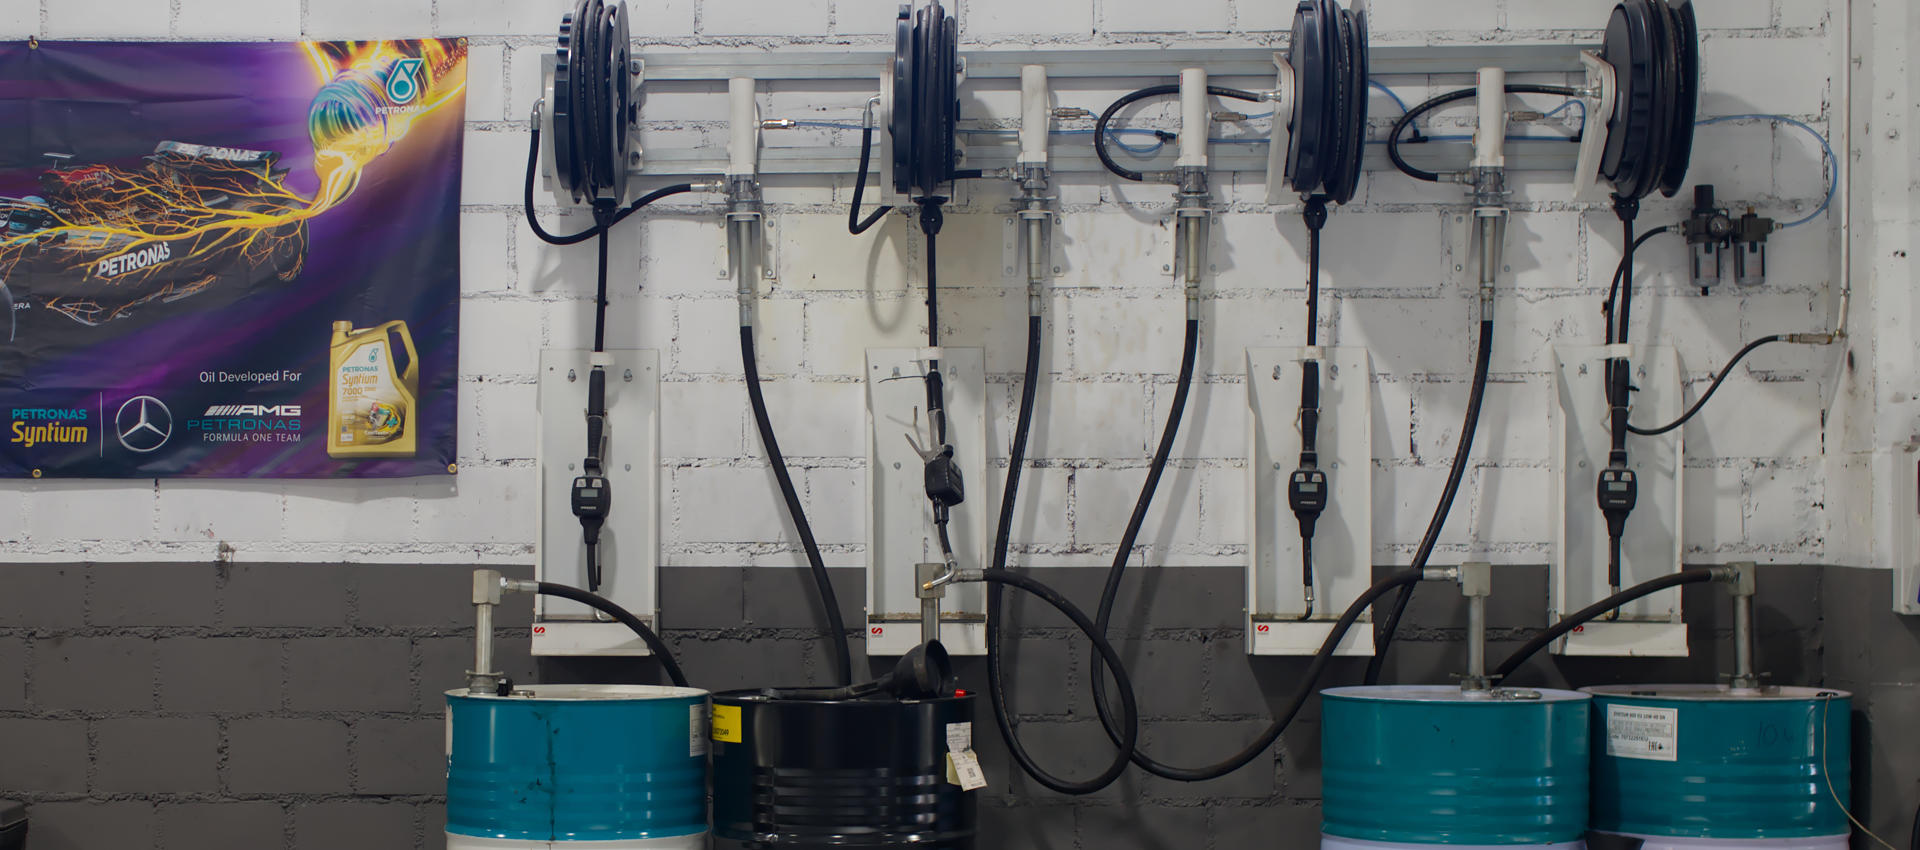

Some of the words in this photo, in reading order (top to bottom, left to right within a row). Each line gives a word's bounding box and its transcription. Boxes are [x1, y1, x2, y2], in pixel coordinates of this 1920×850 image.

[97, 241, 171, 276] PETRONAS
[199, 371, 215, 383] Oil
[219, 370, 279, 384] Developed
[283, 370, 302, 382] For
[342, 373, 378, 387] Syntium
[12, 408, 88, 420] PETRONAS
[234, 405, 301, 416] AMG
[187, 418, 302, 431] PETRONAS
[11, 421, 88, 448] Syntium
[203, 432, 249, 442] FORMULA
[252, 432, 272, 442] ONE
[276, 432, 301, 442] TEAM
